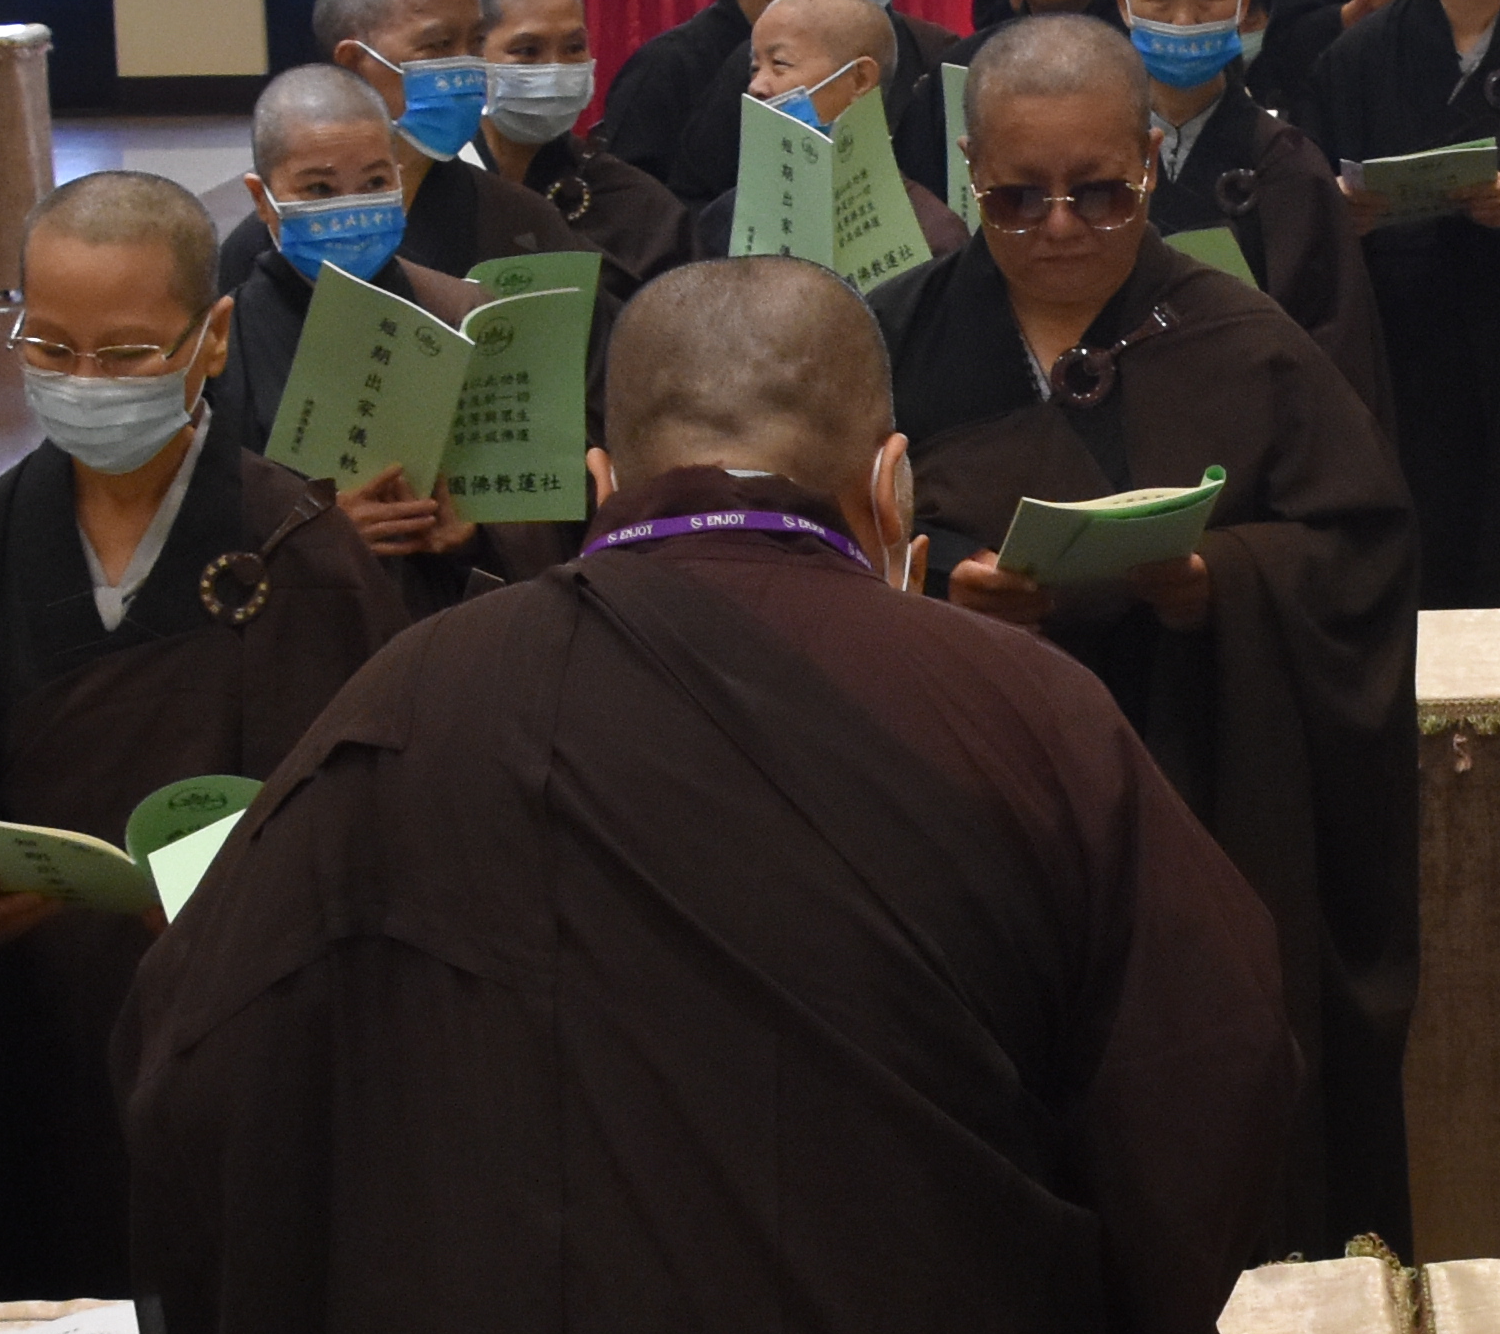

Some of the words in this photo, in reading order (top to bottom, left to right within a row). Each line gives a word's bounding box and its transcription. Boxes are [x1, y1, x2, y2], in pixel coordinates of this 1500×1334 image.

[338, 317, 398, 475] 短期出家儀軌
[706, 513, 746, 527] ENJOY
[619, 524, 654, 540] ENJOY
